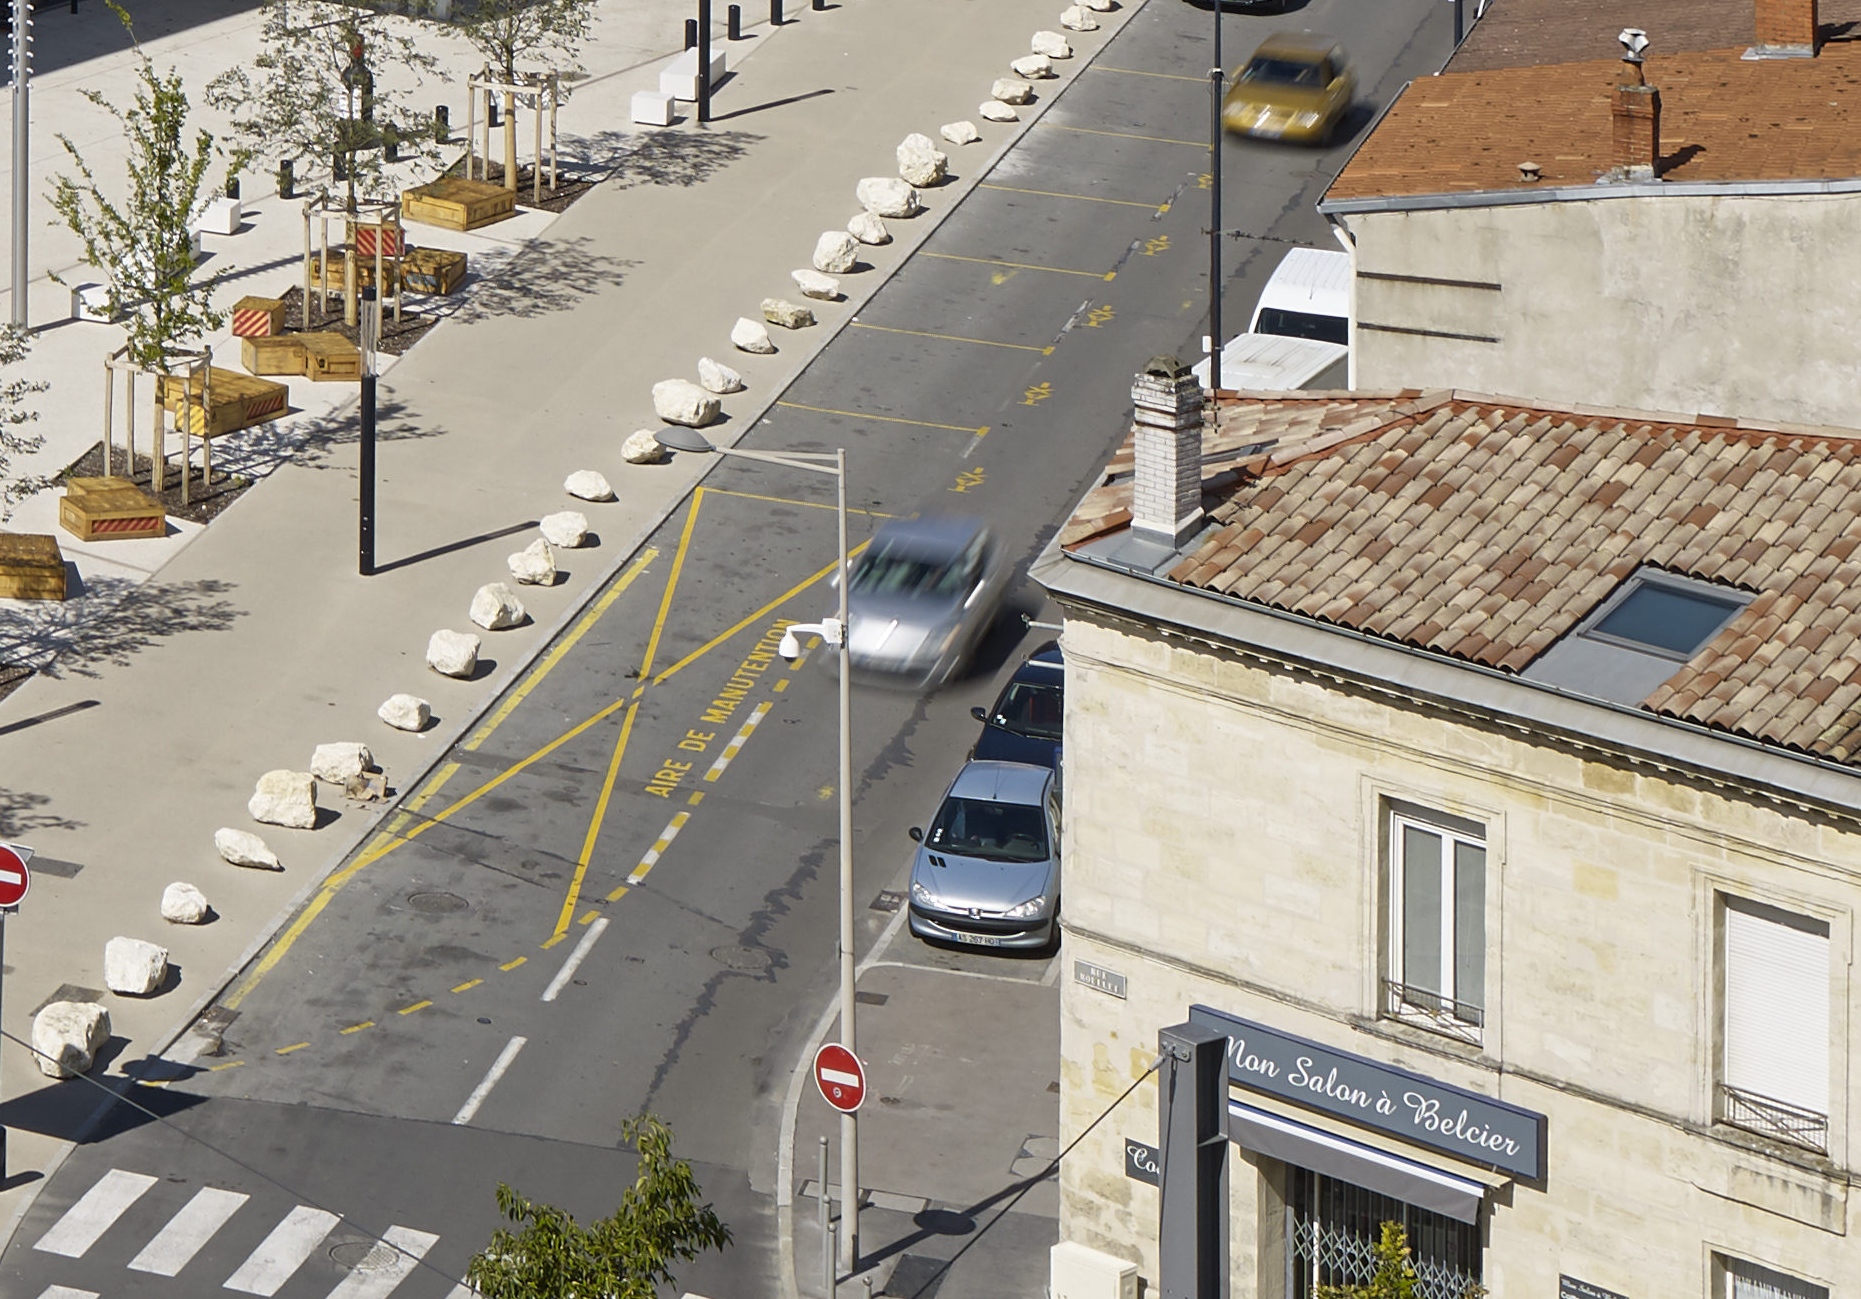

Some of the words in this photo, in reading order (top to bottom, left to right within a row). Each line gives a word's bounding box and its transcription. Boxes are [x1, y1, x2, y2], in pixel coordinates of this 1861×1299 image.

[644, 759, 693, 798] AIRE
[678, 729, 716, 752] DE
[700, 618, 802, 724] MANUTENTION
[1228, 1035, 1281, 1078] Mon
[1288, 1056, 1373, 1108] Salon
[1375, 1090, 1397, 1116] à
[1403, 1091, 1521, 1157] Belcier
